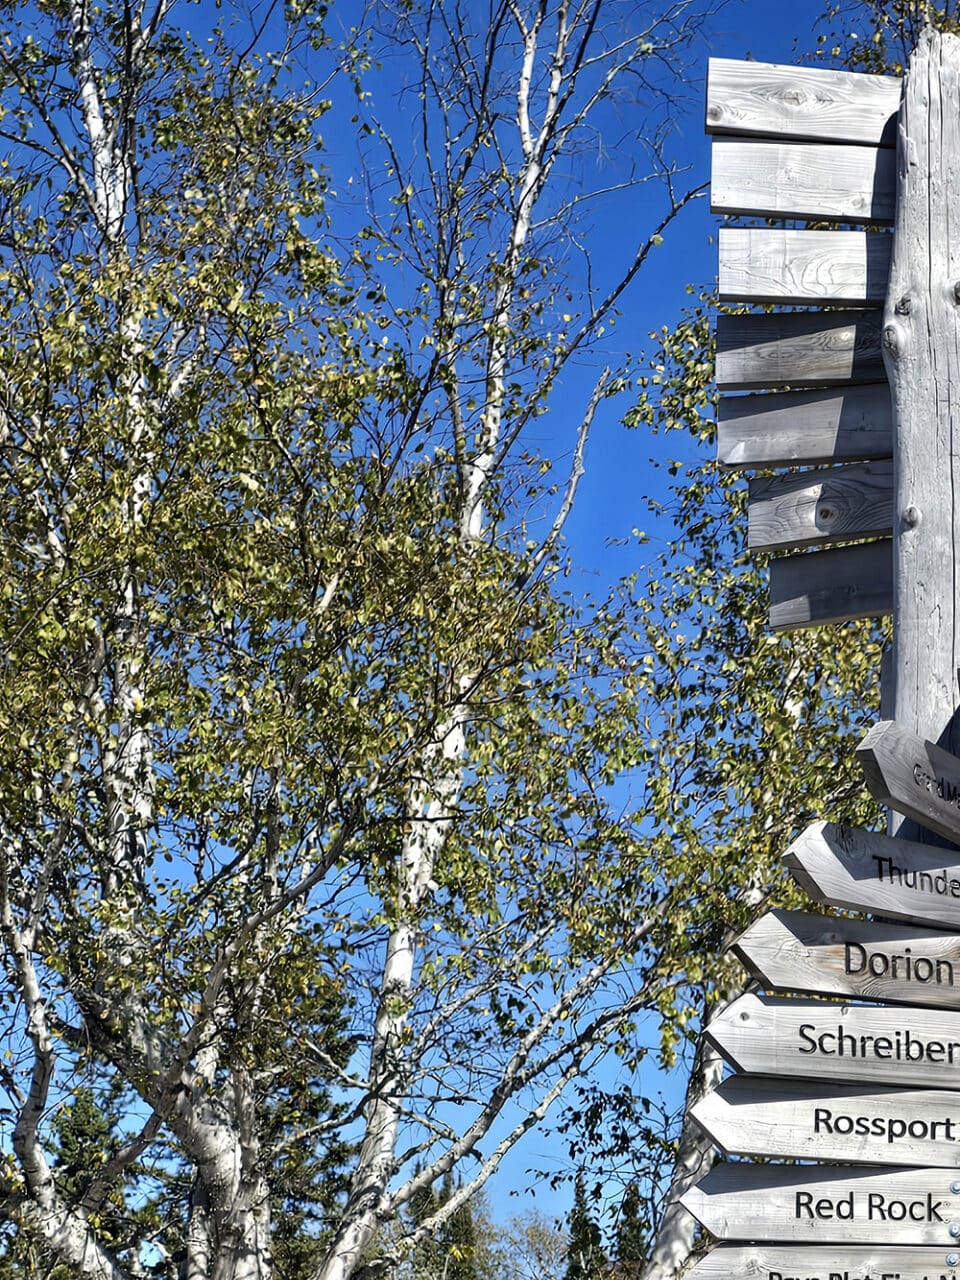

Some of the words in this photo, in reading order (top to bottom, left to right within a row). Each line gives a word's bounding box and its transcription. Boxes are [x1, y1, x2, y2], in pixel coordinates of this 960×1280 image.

[844, 941, 954, 986] Dorion
[798, 1024, 960, 1064] Schreiber
[814, 1108, 956, 1142] Rossport
[795, 1191, 854, 1220] Red
[868, 1192, 944, 1222] Rock
